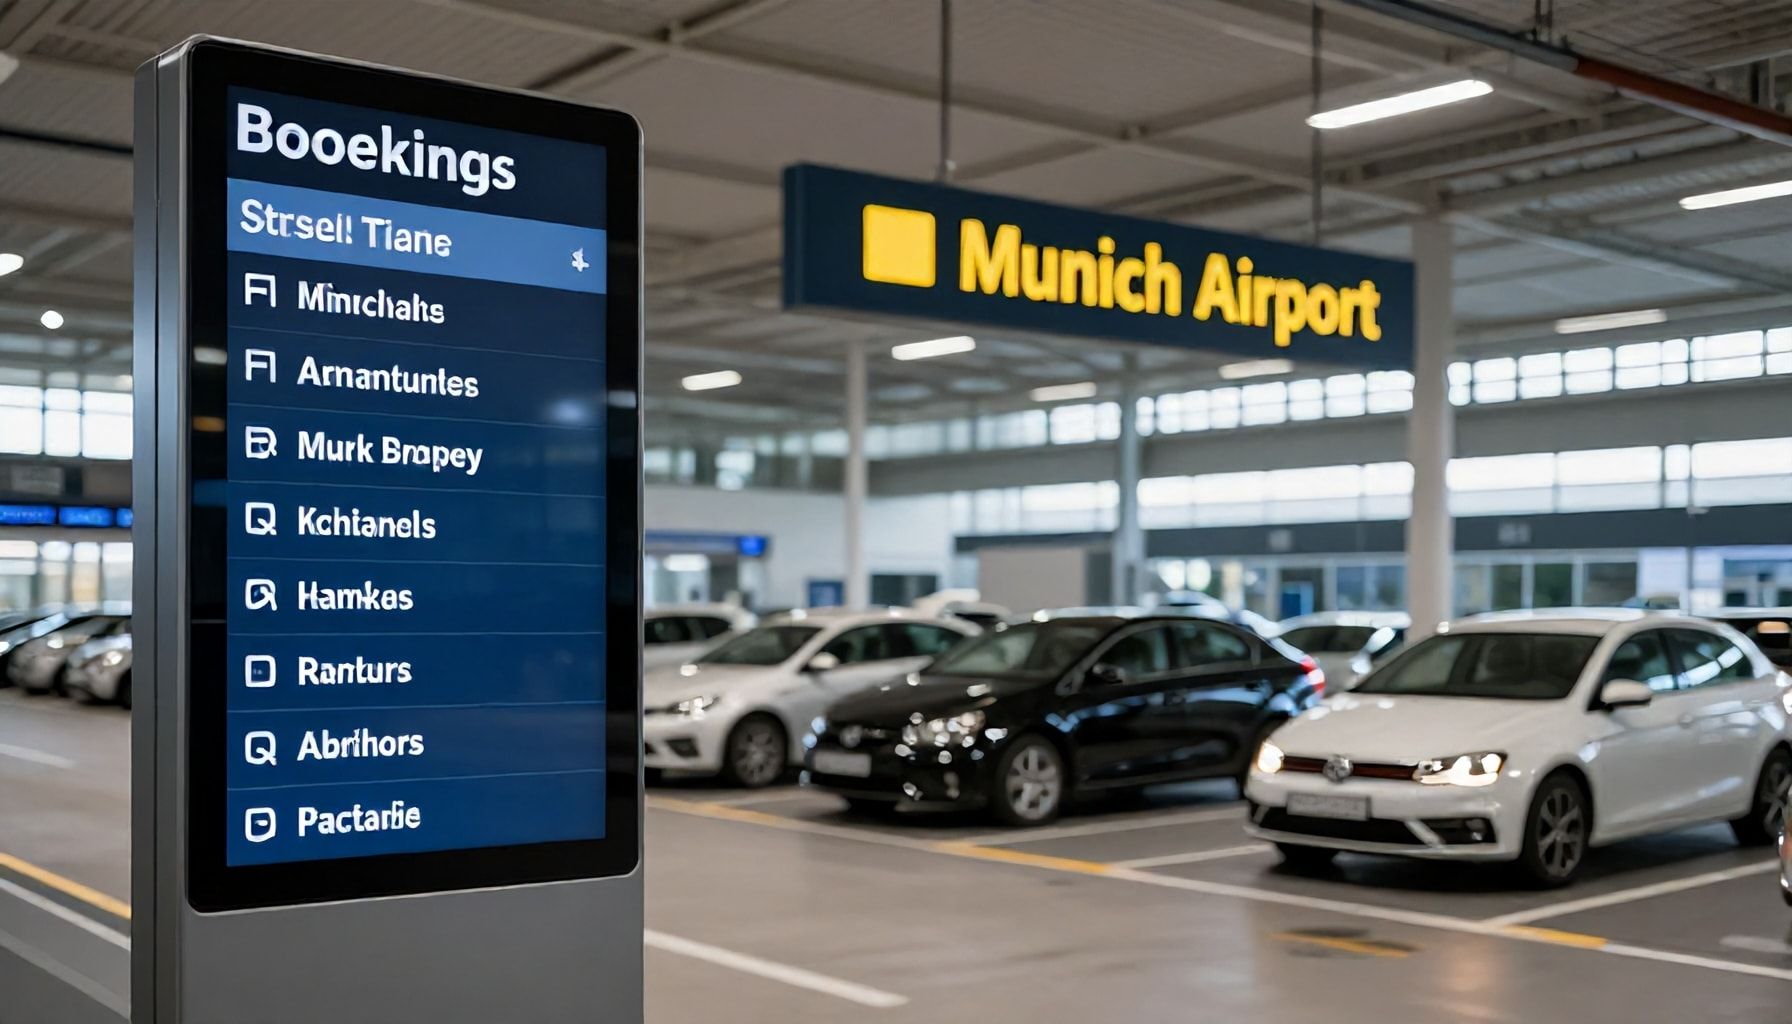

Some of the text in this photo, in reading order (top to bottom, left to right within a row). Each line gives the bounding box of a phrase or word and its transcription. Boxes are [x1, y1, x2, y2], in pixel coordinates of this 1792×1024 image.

[237, 103, 516, 197] Booekings
[959, 217, 1382, 347] Munich Airport
[298, 430, 374, 463] Murk
